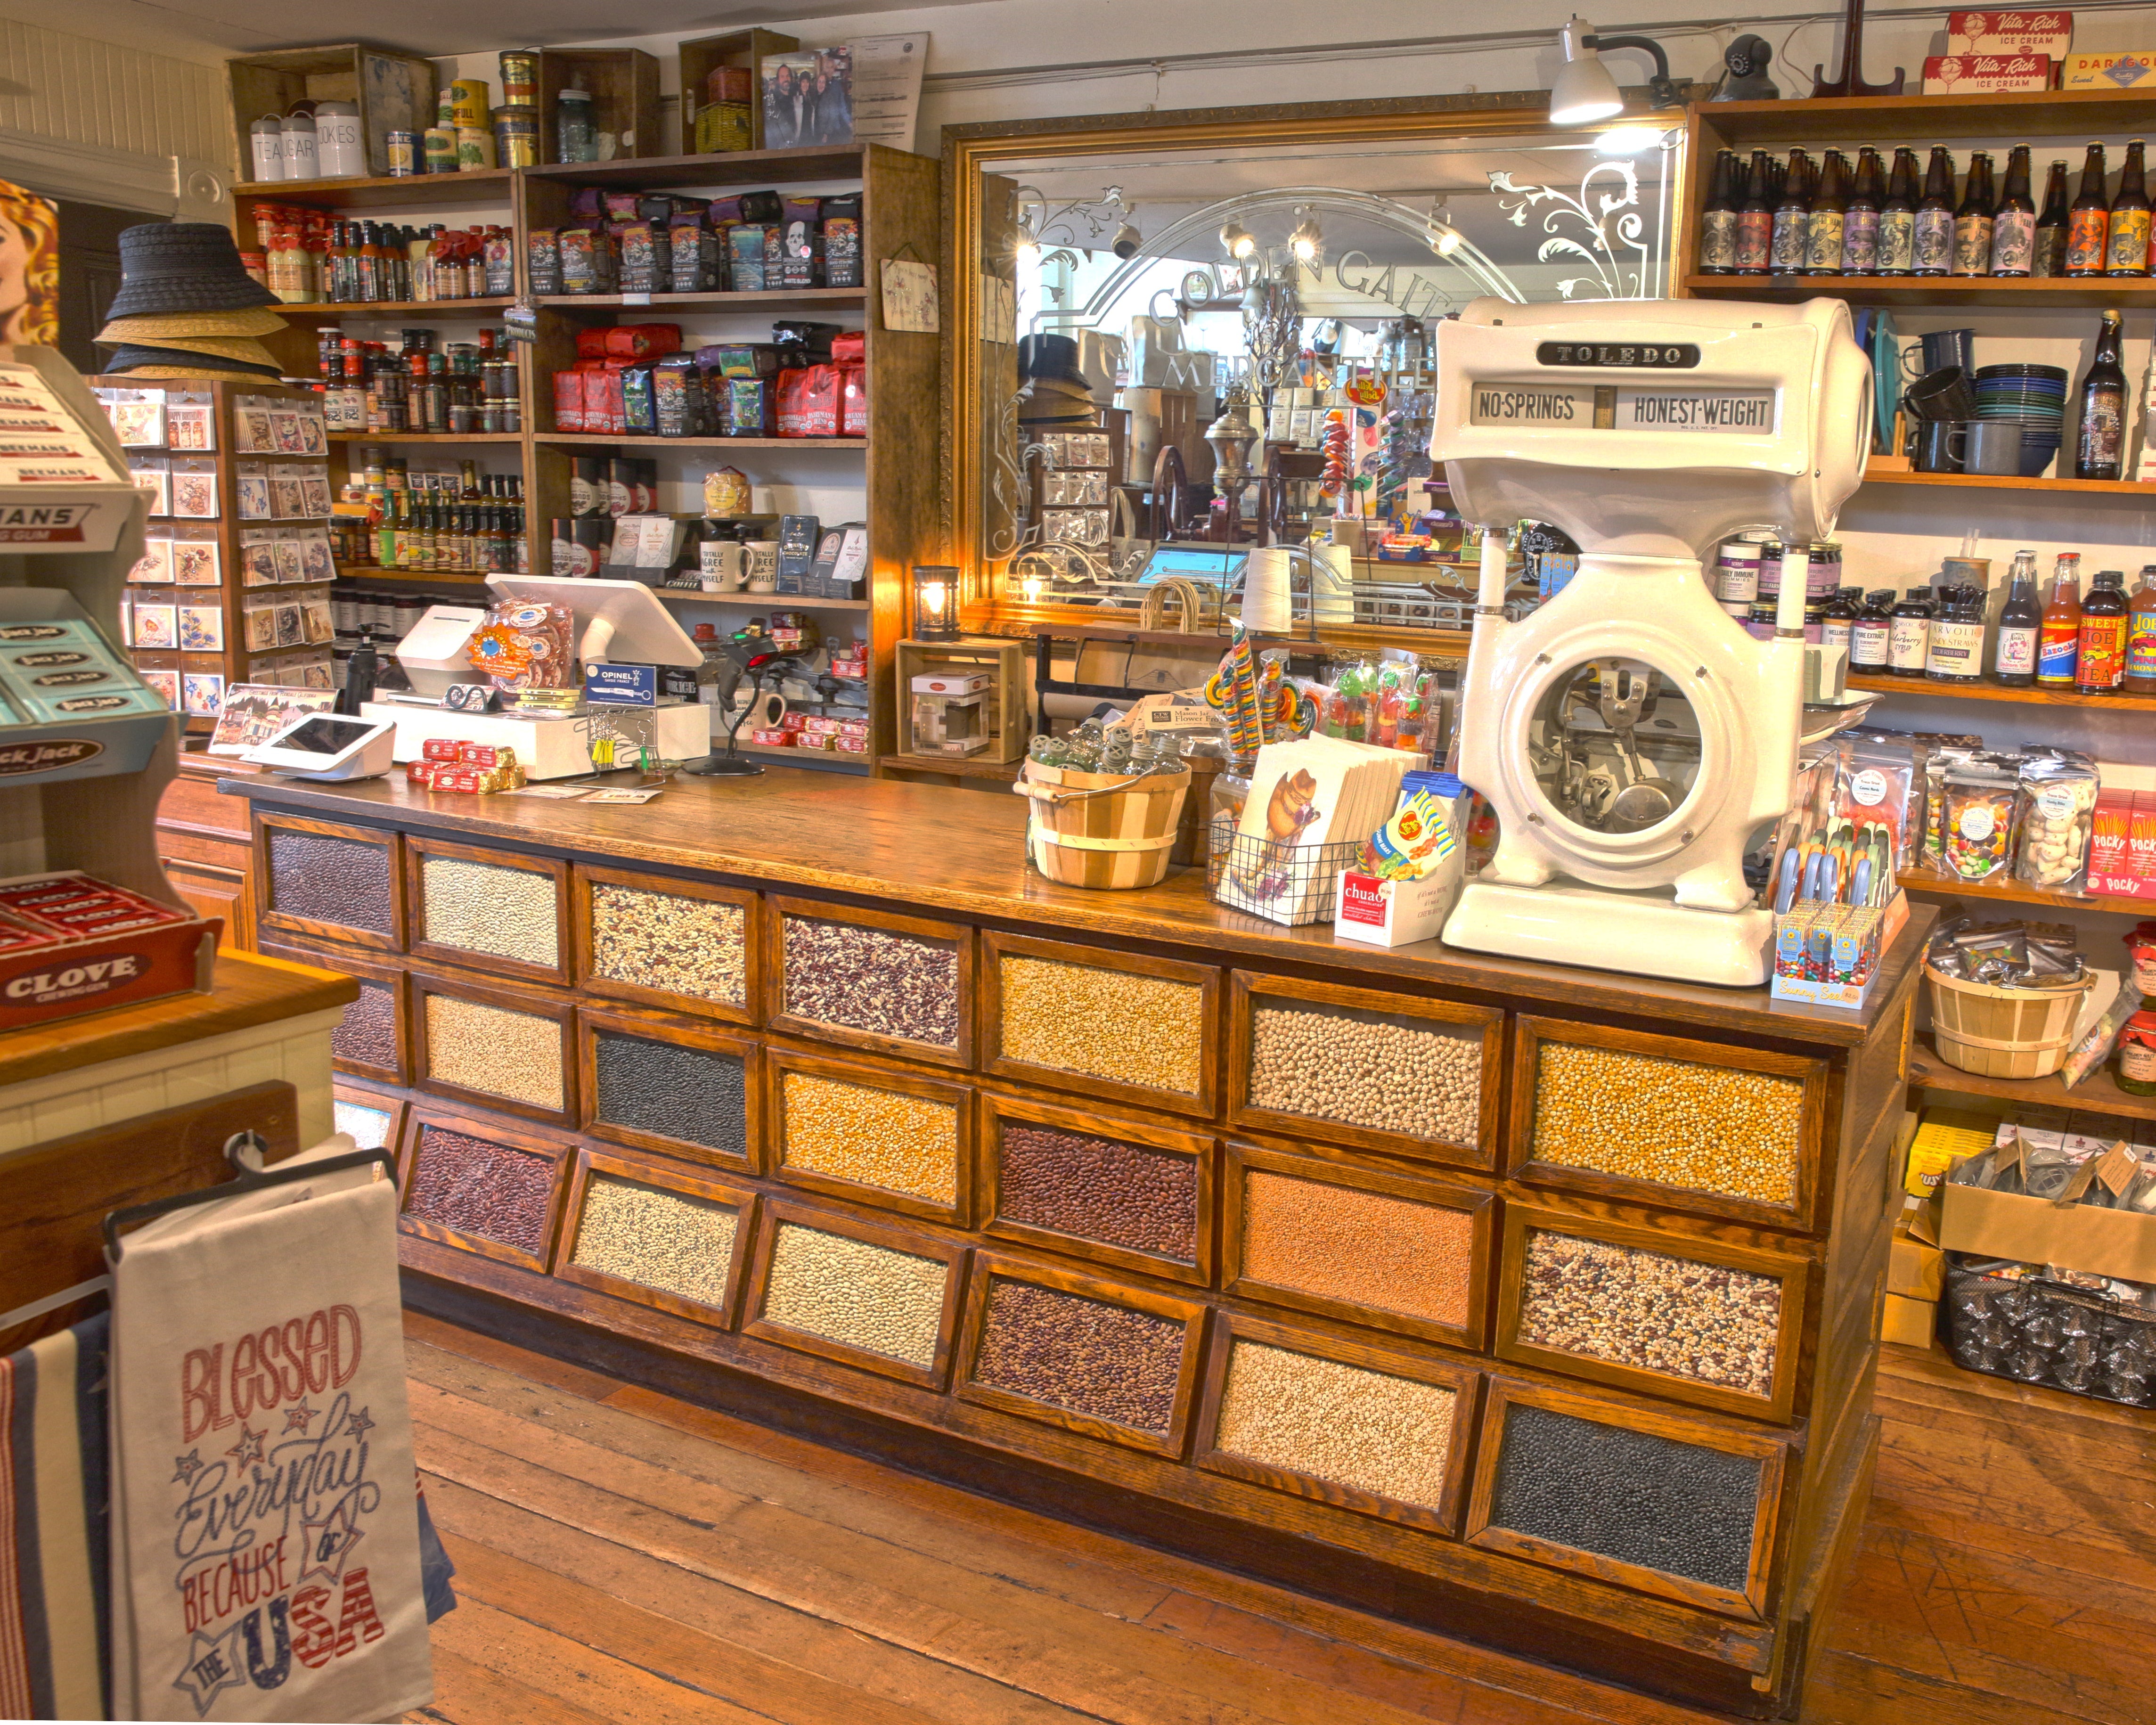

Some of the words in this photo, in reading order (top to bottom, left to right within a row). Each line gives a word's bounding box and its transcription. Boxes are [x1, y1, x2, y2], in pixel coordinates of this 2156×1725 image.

[1997, 14, 2060, 32] Vita-Rich
[1973, 57, 2037, 74] Vita-Rich
[2071, 75, 2093, 84] Sweet
[319, 125, 355, 144] OOKIES
[256, 141, 282, 159] TEA
[284, 139, 314, 157] UGAR
[1149, 245, 1326, 327] GOLDEN
[1336, 249, 1452, 323] GAIT
[1556, 346, 1681, 363] TOLEDO
[1161, 354, 1436, 397] MERCANTILE
[1734, 570, 1755, 579] IMMUNE
[2082, 617, 2117, 628] SWEET
[1947, 638, 1978, 648] STRAWS
[2082, 631, 2114, 645] JOE
[1933, 647, 1968, 657] ELDERBERRY
[602, 671, 632, 680] OPINEL
[2081, 667, 2111, 681] TEA
[32, 741, 83, 762] Jack
[1375, 828, 1383, 842] GUMMI
[1380, 840, 1392, 855] BEARS
[2093, 834, 2126, 851] Pocky
[2130, 838, 2156, 854] Pock
[1345, 883, 1384, 903] chuao
[2106, 877, 2140, 894] Pocky
[1358, 899, 1383, 907] CHOCOLATIER
[7, 956, 137, 997] CLOVE
[1779, 979, 1816, 1003] Sunny
[1820, 985, 1844, 1001] See
[1845, 992, 1859, 1000] $2.50
[174, 1391, 381, 1592] Everyday
[184, 1535, 290, 1634] BECAUSE
[192, 1648, 229, 1691] THE
[242, 1566, 385, 1691] USA
